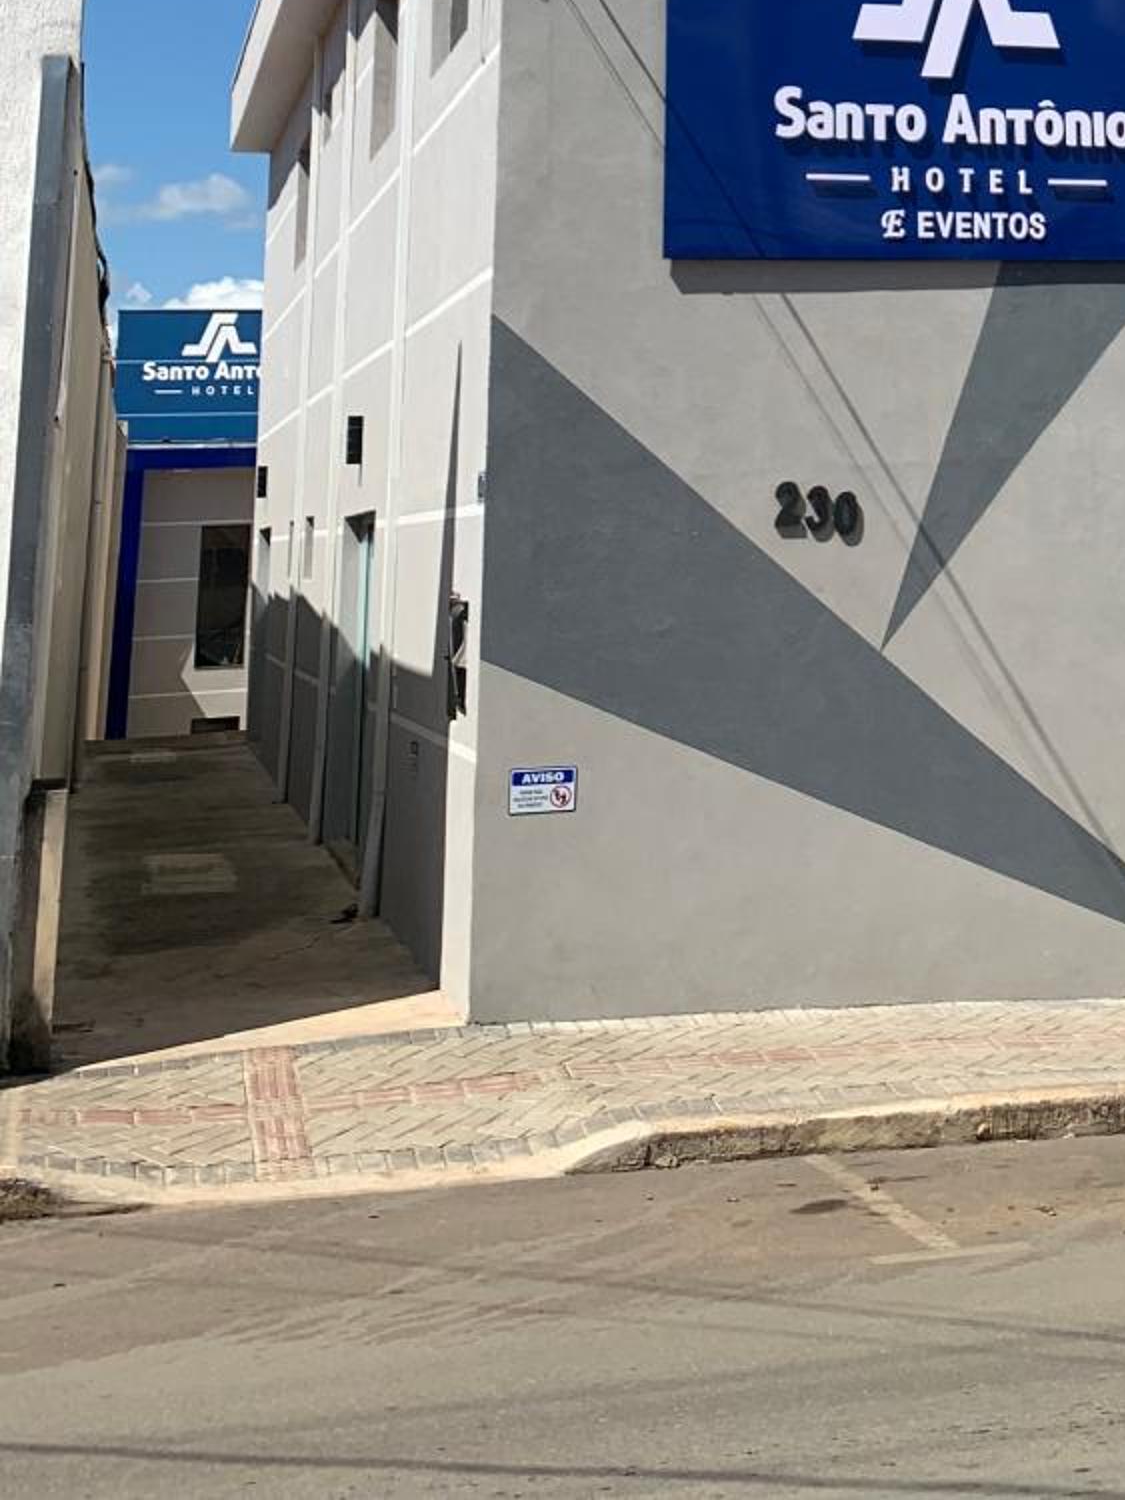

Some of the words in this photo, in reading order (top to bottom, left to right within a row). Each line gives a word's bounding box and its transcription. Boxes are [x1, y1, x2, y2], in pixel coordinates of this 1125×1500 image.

[891, 166, 1033, 194] HOTEL
[917, 211, 1047, 240] EVENTOS
[191, 385, 255, 396] HOTEL
[775, 481, 865, 547] 230
[521, 771, 565, 784] AVISO
